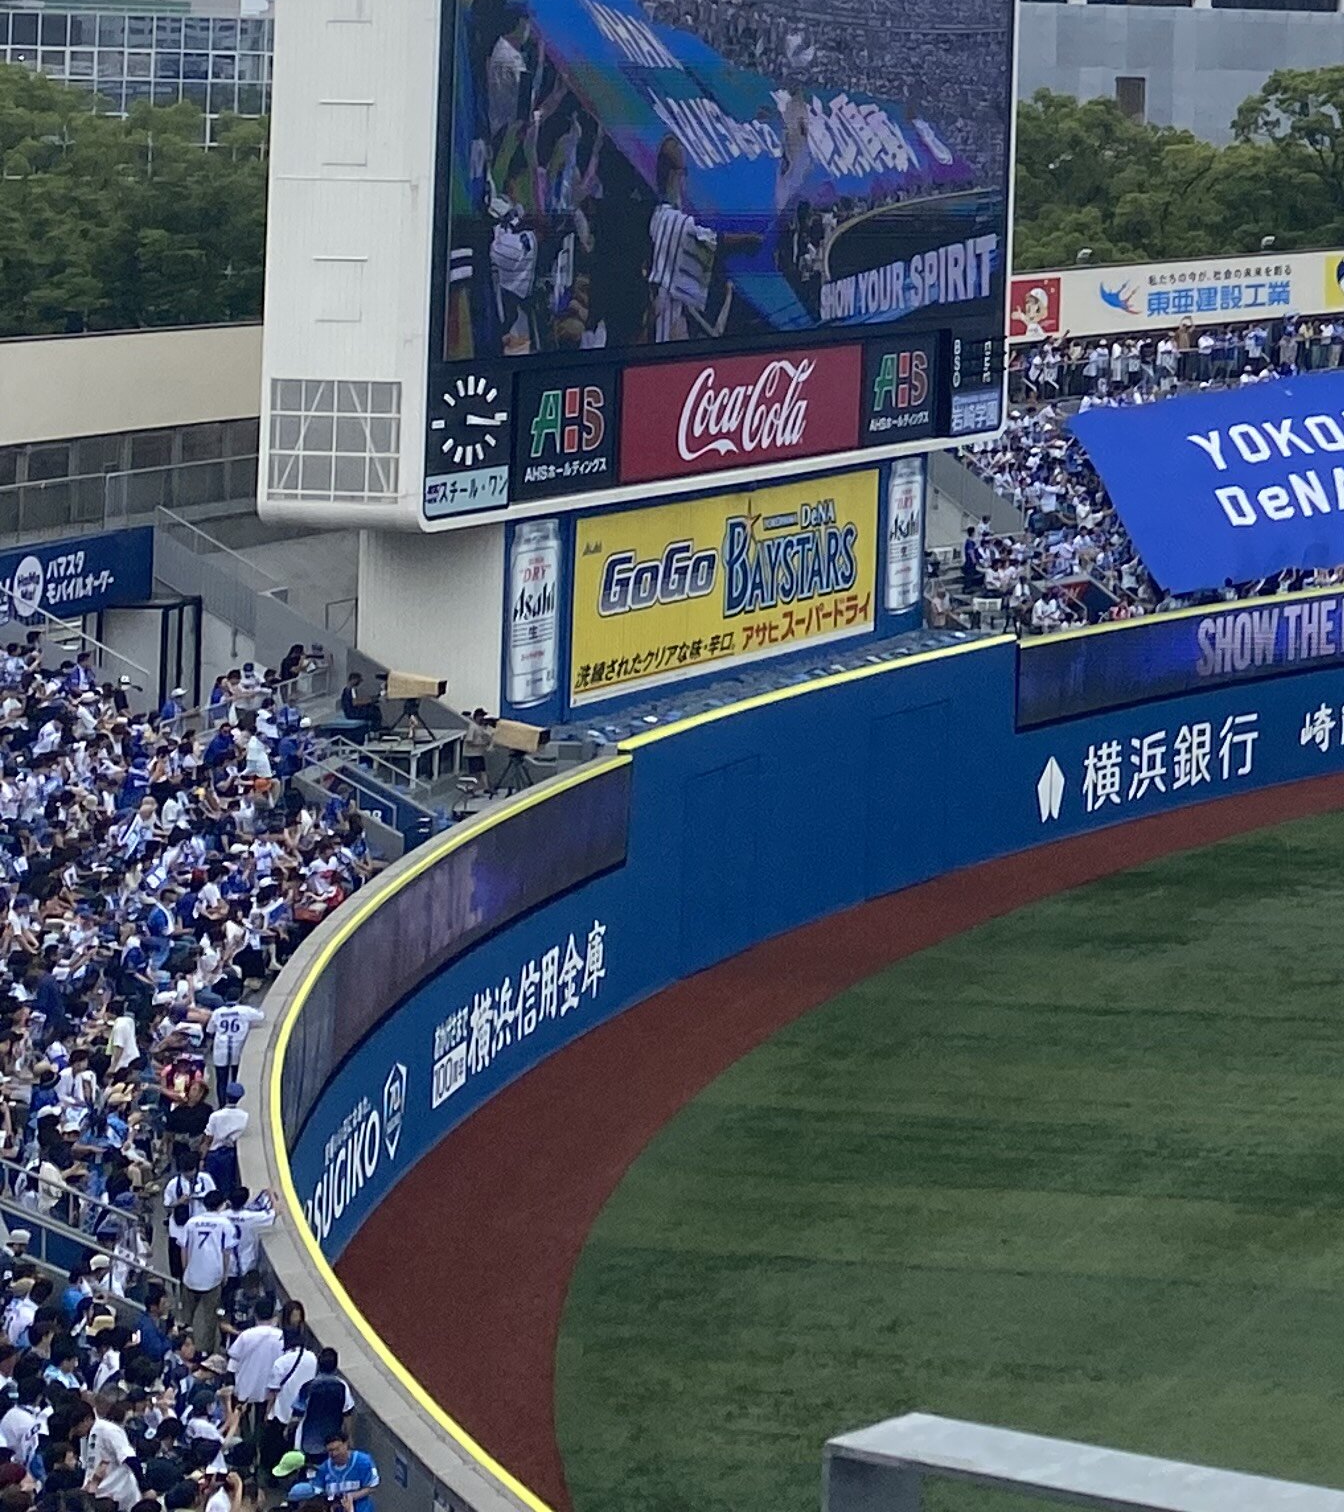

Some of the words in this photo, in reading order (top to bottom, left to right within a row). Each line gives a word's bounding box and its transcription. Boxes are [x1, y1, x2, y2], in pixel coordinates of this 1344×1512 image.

[820, 276, 856, 321] SHOW
[859, 260, 904, 315] YOUR
[910, 233, 998, 308] SPIRIT
[1146, 279, 1291, 317] 東亜建設工業
[869, 410, 929, 432] AHSホールディングス
[524, 457, 607, 483] AHSホールディングス
[801, 498, 837, 529] DeNA
[46, 551, 85, 580] ハマスタ
[723, 515, 858, 619] BAYSTARS
[46, 569, 115, 605] モバイルオーダー
[513, 581, 556, 622] Asahi
[528, 625, 539, 639] 生
[742, 592, 872, 651] アサヒスーパードライ
[1196, 607, 1281, 678] SHOW
[1284, 598, 1337, 664] THE
[1082, 712, 1259, 813] 横浜銀行
[468, 919, 606, 1075] 横浜信用金庫
[218, 1018, 240, 1034] 96
[198, 1230, 210, 1250] 7
